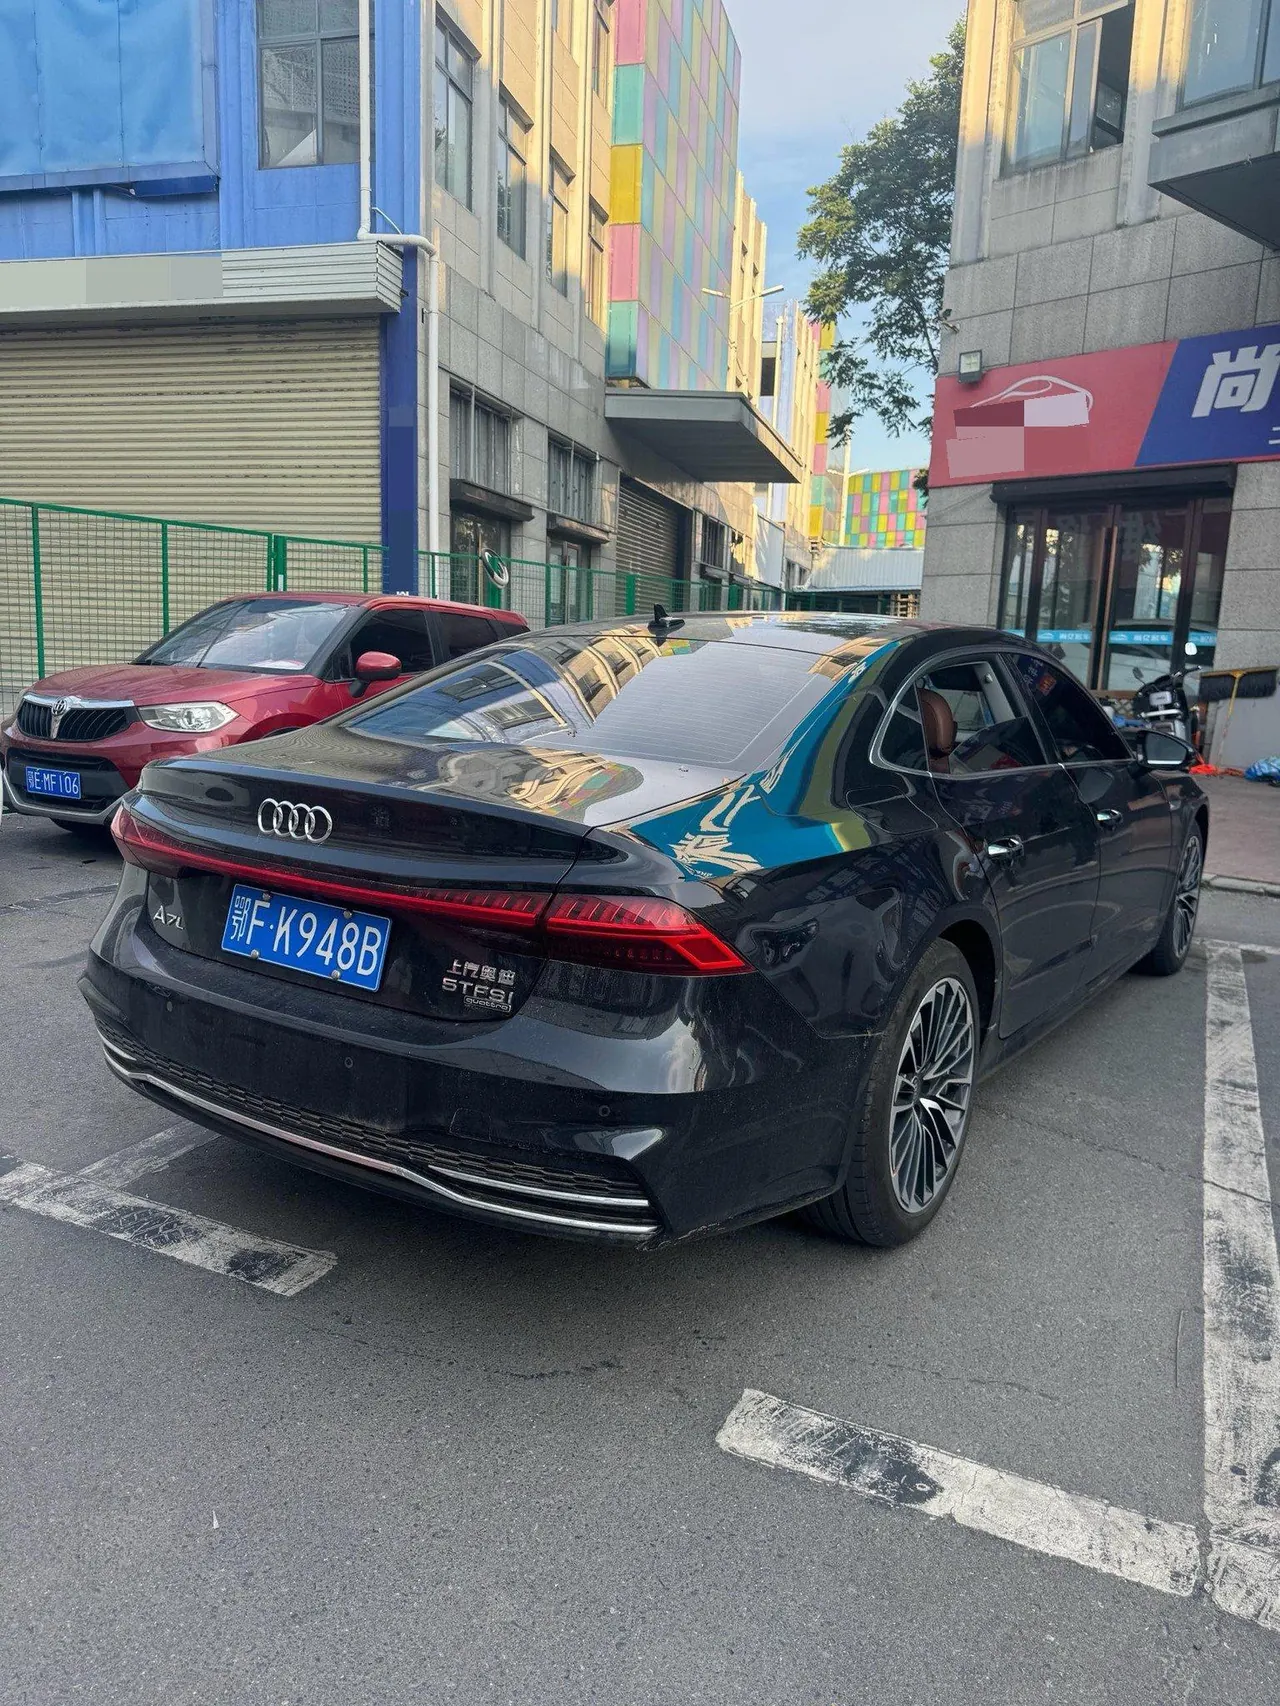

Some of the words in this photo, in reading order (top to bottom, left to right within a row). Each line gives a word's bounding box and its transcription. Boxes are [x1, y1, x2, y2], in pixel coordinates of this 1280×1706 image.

[1192, 344, 1280, 418] 尚
[153, 905, 184, 930] A7L
[446, 959, 516, 986] 上汽奥迪
[465, 997, 510, 1011] quattro
